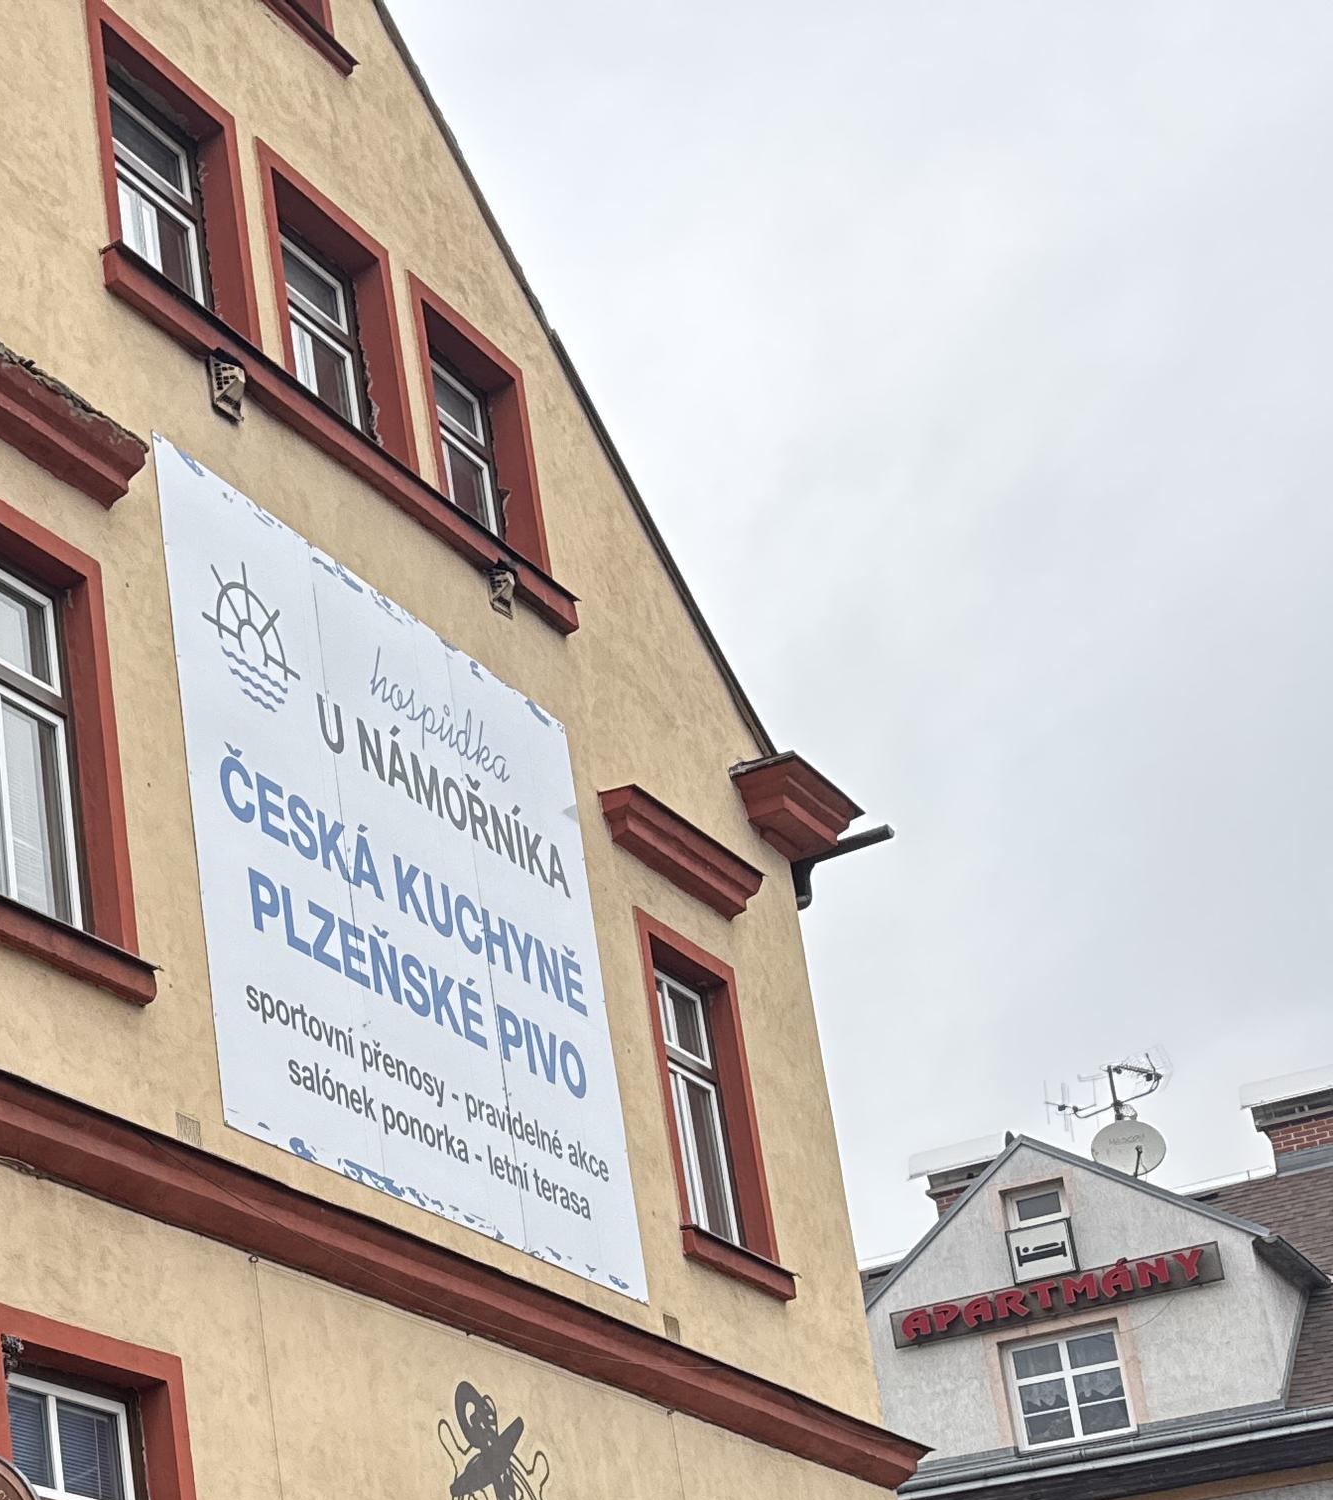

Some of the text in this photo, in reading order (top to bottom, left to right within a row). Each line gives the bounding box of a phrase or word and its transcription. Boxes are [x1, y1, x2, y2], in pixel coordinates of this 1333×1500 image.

[316, 692, 571, 898] U NÁMOŘNÍKA
[370, 646, 510, 783] hospůdka
[220, 741, 588, 1017] ČESKÁ KUCHYNĚ
[248, 867, 587, 1099] PLZEŇSKÉ PIVO
[246, 985, 354, 1059] sportovní
[360, 1040, 445, 1107] přenosy
[465, 1092, 562, 1159] pravidelné
[568, 1142, 609, 1182] akce
[288, 1059, 376, 1122] salónek
[382, 1102, 469, 1165] ponorka
[487, 1144, 529, 1191] letní
[534, 1168, 591, 1221] terasa
[901, 1247, 1203, 1340] APARTMÁNY
